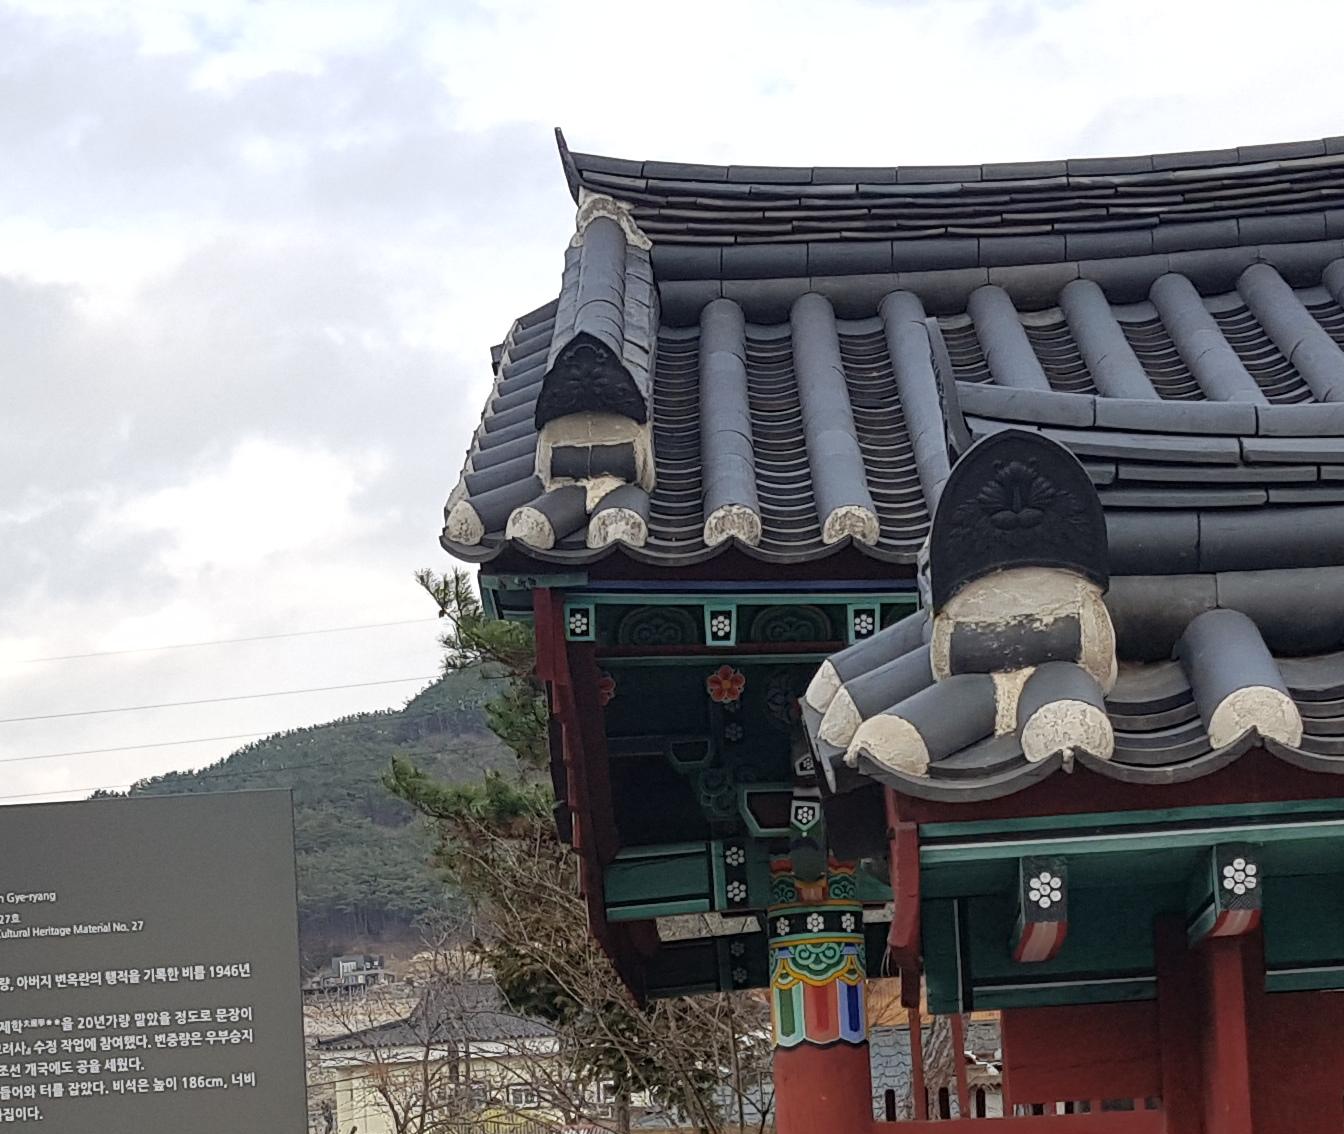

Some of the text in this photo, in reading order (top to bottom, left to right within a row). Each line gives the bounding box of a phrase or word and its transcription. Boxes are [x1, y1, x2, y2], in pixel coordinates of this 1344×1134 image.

[6, 892, 56, 903] Gye-ryang
[32, 925, 71, 936] Heritage
[73, 922, 110, 934] Material
[112, 922, 129, 931] No.
[131, 920, 143, 930] 27
[16, 974, 51, 989] 아버지
[54, 971, 101, 987] 변옥란의
[143, 966, 179, 982] 기록한
[209, 962, 250, 977] 1946년
[77, 1013, 130, 1029] 20년가량
[174, 1009, 212, 1024] 정도로
[215, 1006, 252, 1022] 문장이
[33, 1039, 57, 1054] 수정
[60, 1037, 96, 1052] 작업에
[99, 1034, 151, 1050] 참여했다.
[154, 1031, 202, 1047] 변중량은
[204, 1028, 252, 1044] 우부승지
[24, 1060, 73, 1076] 개국에도
[75, 1058, 101, 1073] 공을
[103, 1056, 144, 1072] 세웠다.
[39, 1082, 64, 1097] 터를
[67, 1080, 108, 1096] 잡았다.
[112, 1078, 149, 1093] 비석은
[152, 1076, 176, 1091] 높이
[181, 1075, 227, 1088] 186cm,
[231, 1071, 255, 1087] 너비
